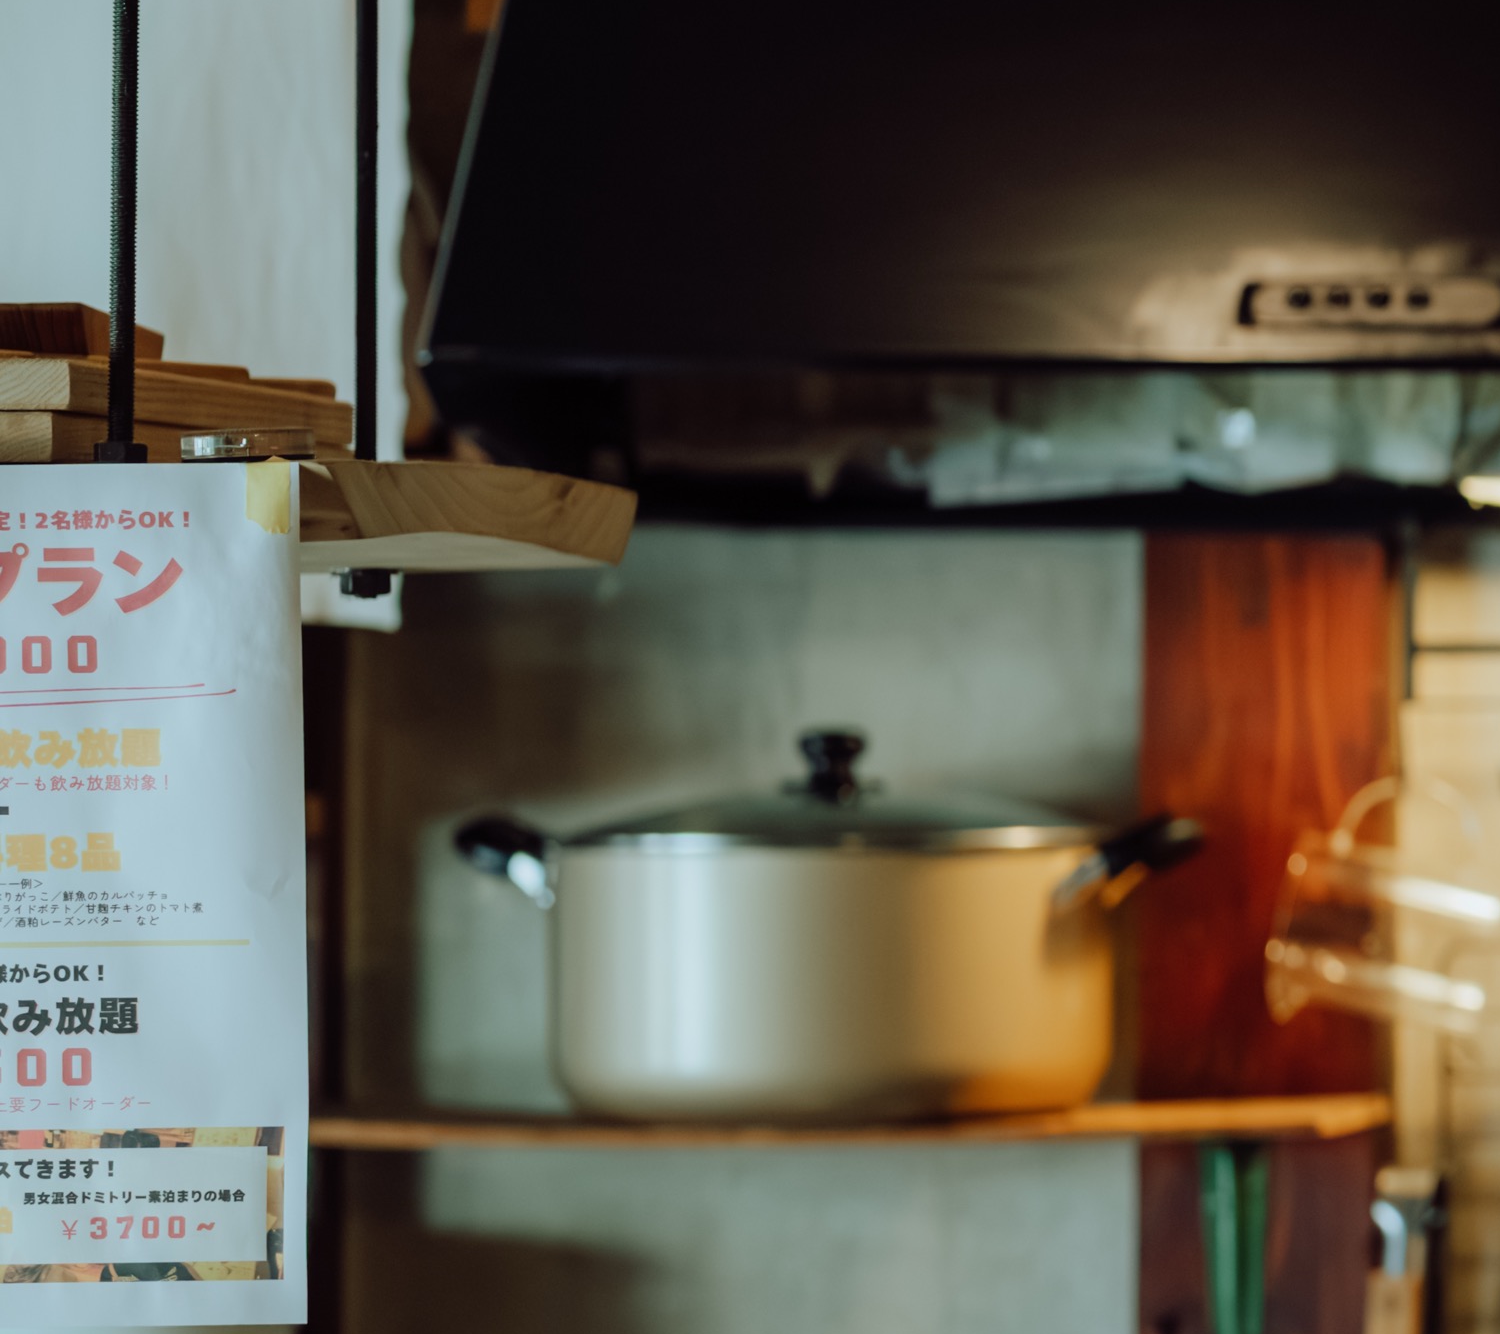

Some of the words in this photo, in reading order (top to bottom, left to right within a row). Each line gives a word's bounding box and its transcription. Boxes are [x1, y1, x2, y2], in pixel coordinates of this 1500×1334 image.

[0, 635, 98, 674] 00
[0, 832, 121, 872] 理8品
[0, 890, 168, 902] りがっこ／鮮魚のカルパッチョ
[0, 996, 139, 1036] み放題
[0, 1047, 92, 1087] 00
[23, 1189, 246, 1205] 男女混合ドミトリー素泊まりの場合
